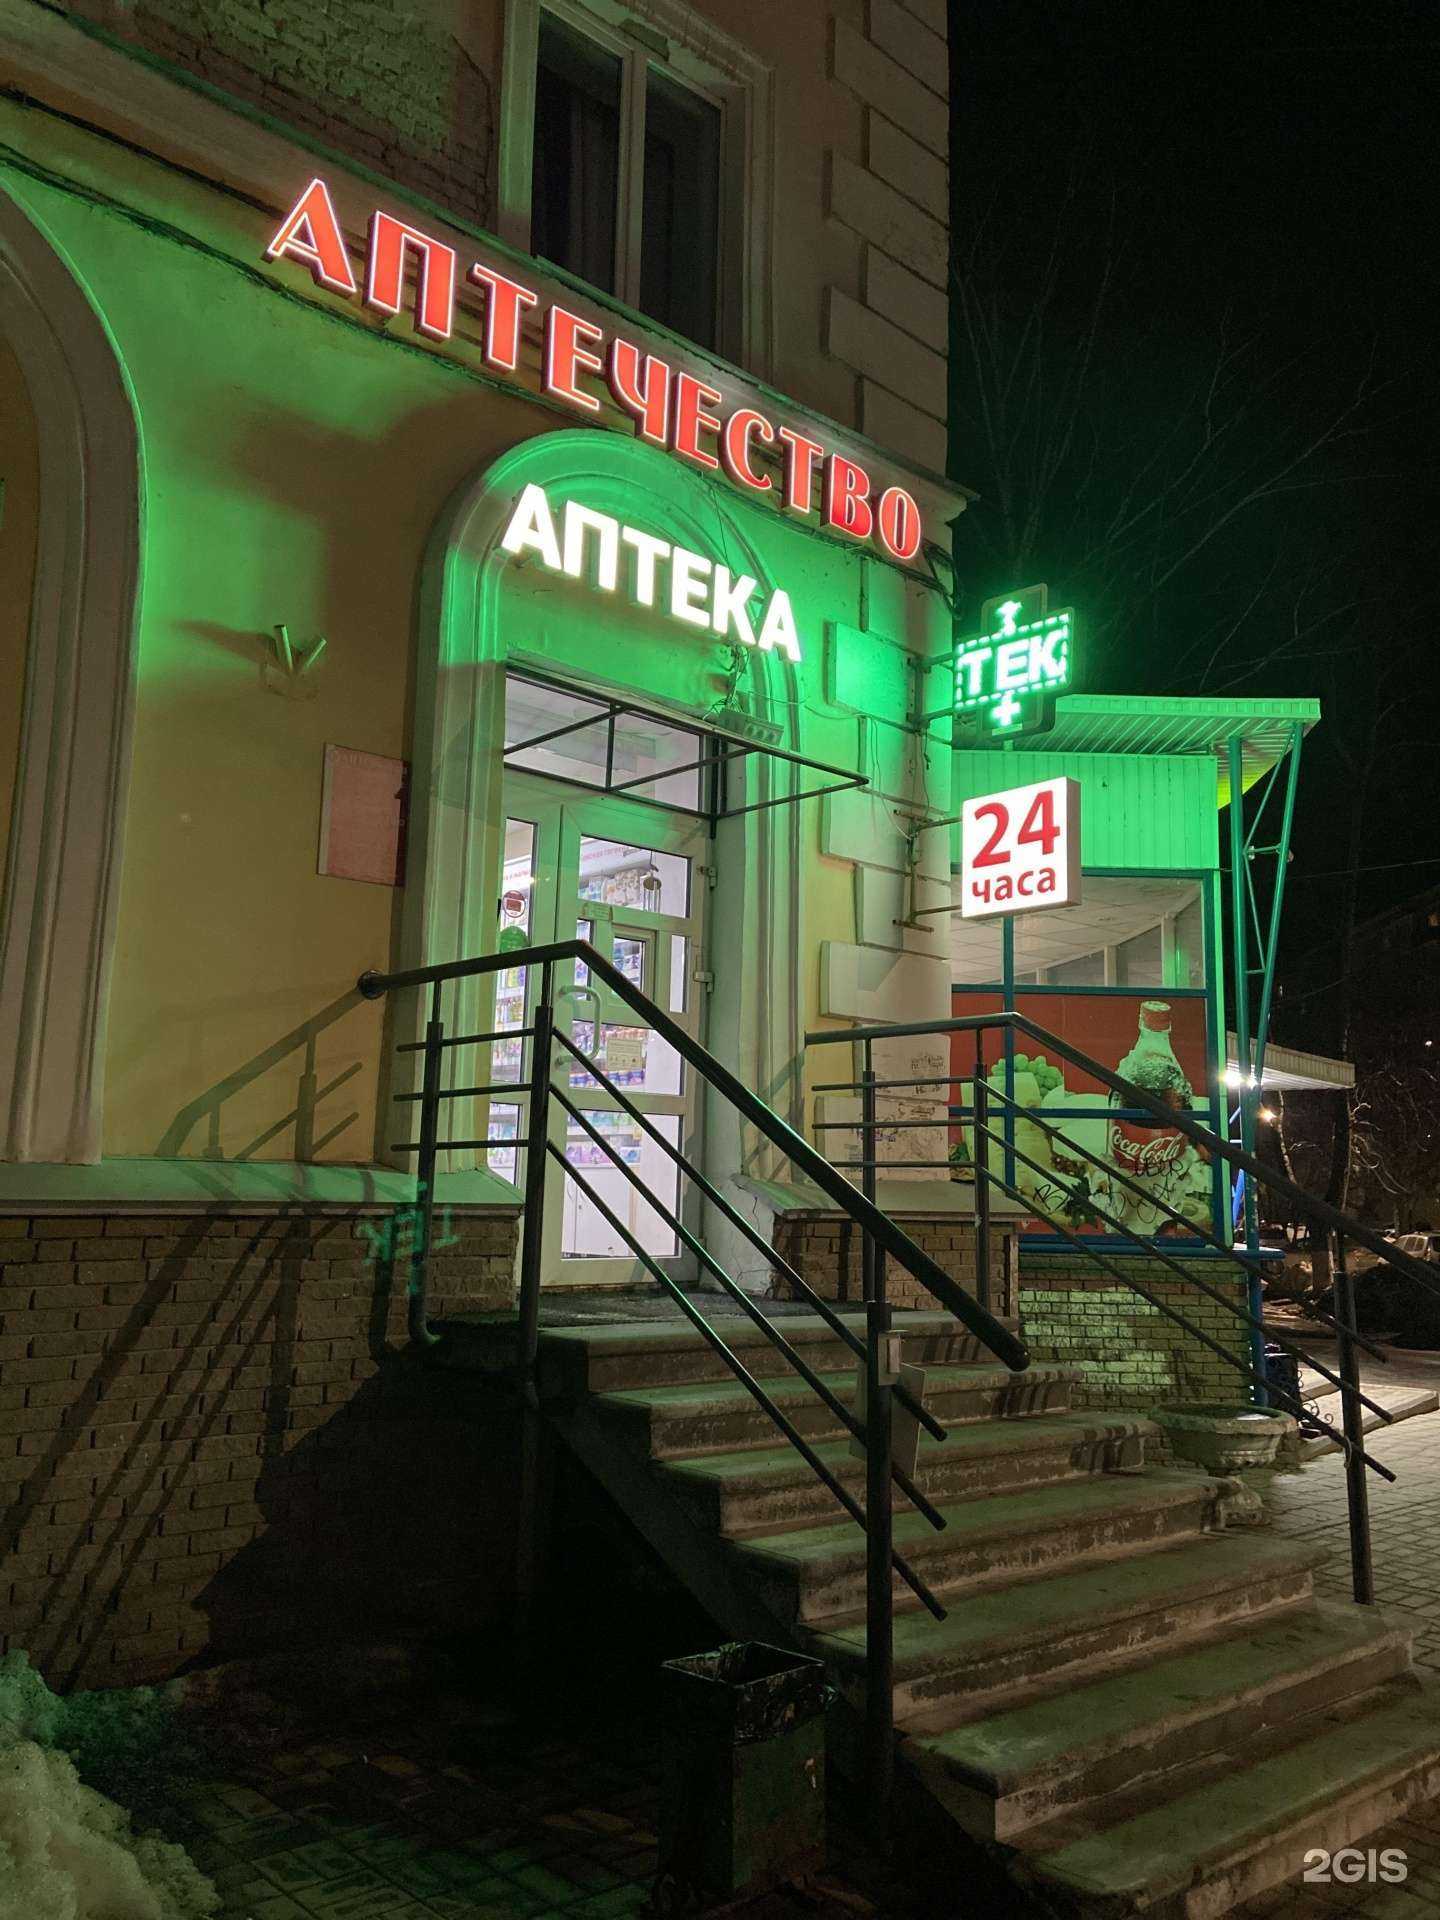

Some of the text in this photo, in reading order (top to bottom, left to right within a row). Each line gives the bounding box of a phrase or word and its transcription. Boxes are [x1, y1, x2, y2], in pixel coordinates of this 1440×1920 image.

[266, 177, 921, 561] АПТЕЧЕСТВО
[501, 482, 802, 663] АПТЕКА
[972, 789, 1061, 869] 24
[972, 866, 1057, 904] часа
